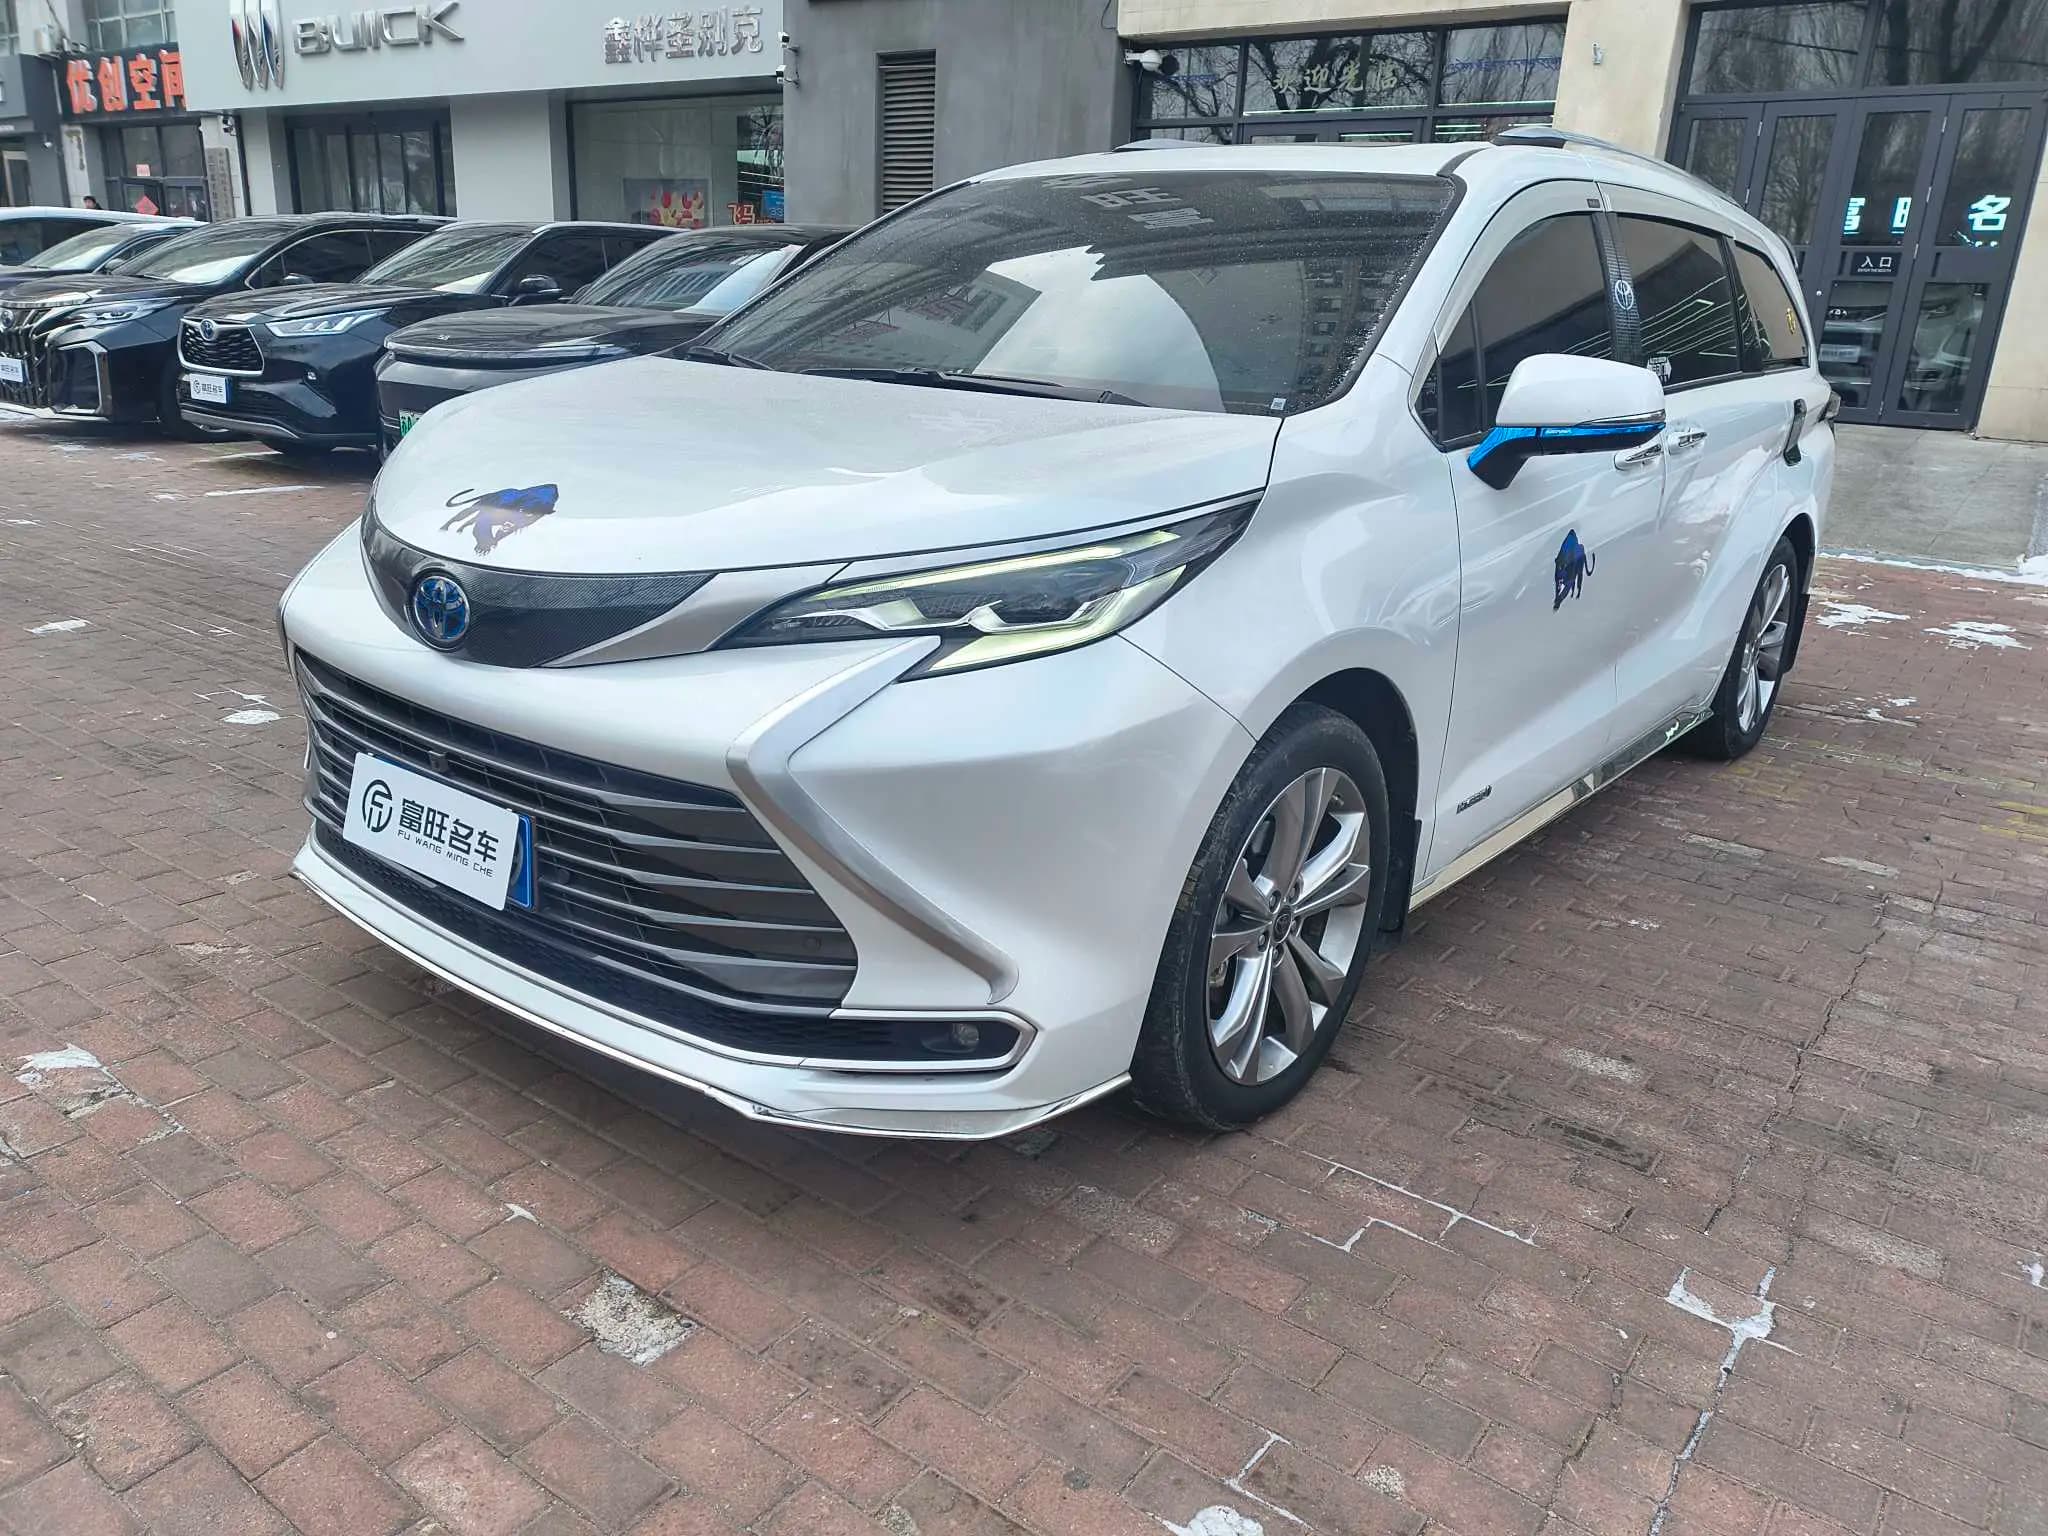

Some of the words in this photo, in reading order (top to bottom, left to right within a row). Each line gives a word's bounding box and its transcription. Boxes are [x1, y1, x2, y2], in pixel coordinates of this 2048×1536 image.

[293, 1, 465, 55] BUICK
[66, 49, 187, 114] 优创空间
[1272, 60, 1398, 94] 欢迎光临
[1861, 256, 1892, 268] 入口
[397, 829, 411, 841] FU
[415, 836, 442, 854] WANG
[446, 850, 469, 867] MING
[473, 862, 494, 878] CHE
[399, 798, 499, 863] 富旺名车
